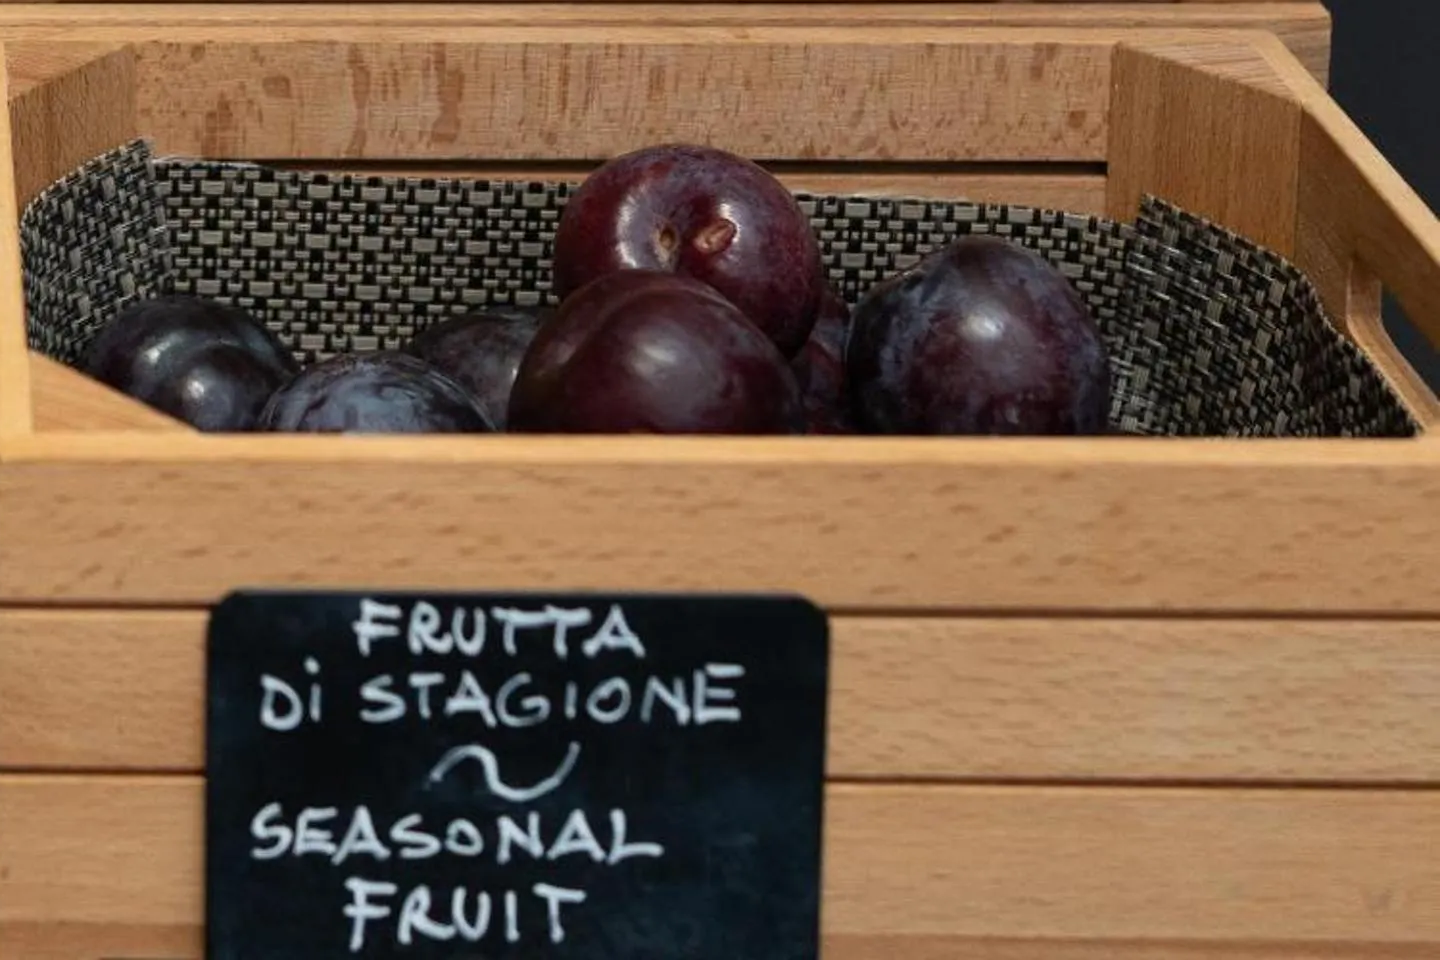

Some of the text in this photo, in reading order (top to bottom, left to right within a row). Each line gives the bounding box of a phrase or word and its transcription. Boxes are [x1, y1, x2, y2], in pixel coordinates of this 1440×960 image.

[353, 599, 646, 657] FRUTTA
[360, 663, 745, 728] STAGIONE
[250, 802, 664, 865] SEASONAL
[343, 877, 587, 951] FRUIT
